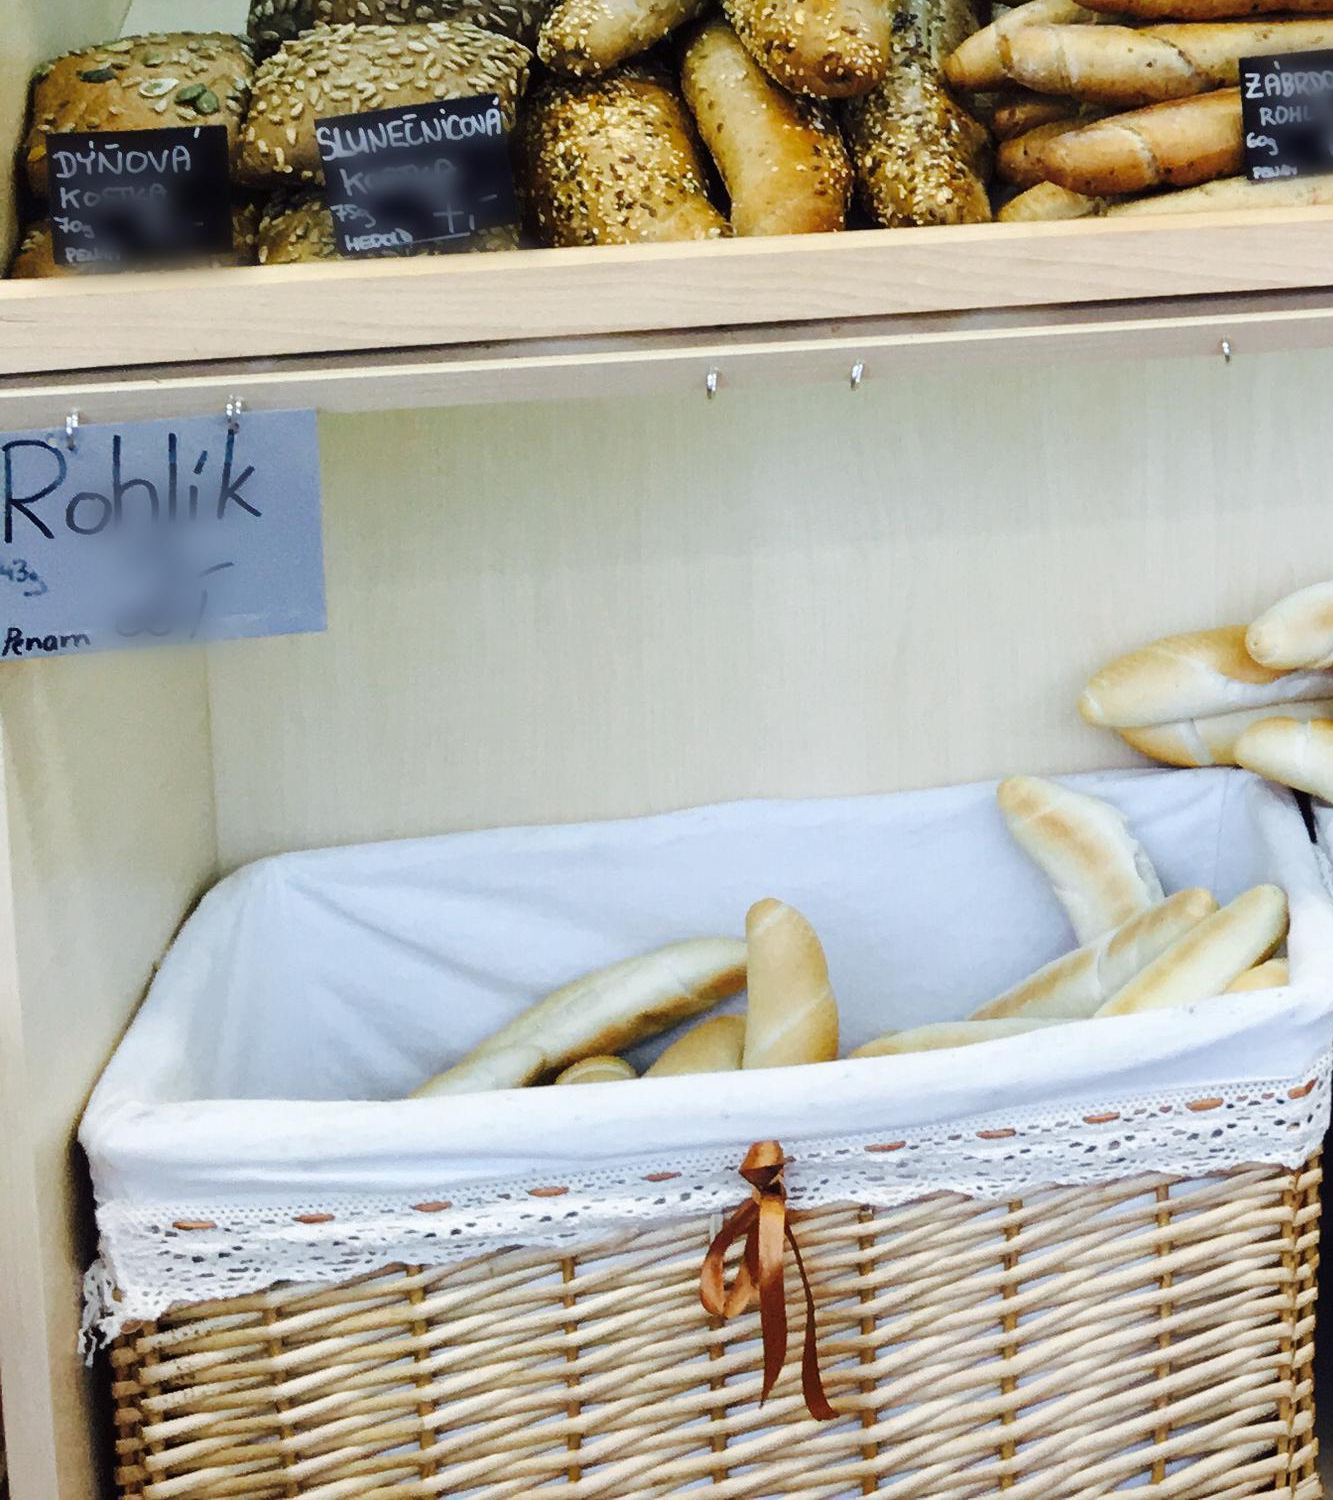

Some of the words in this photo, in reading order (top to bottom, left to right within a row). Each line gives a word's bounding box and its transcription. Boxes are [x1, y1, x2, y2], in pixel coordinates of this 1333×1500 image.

[52, 127, 201, 179] DÝŇOVÁ
[315, 97, 503, 162] SLUNEČNICOVÁ
[2, 428, 263, 544] Rohlík
[1, 626, 92, 658] Penam
